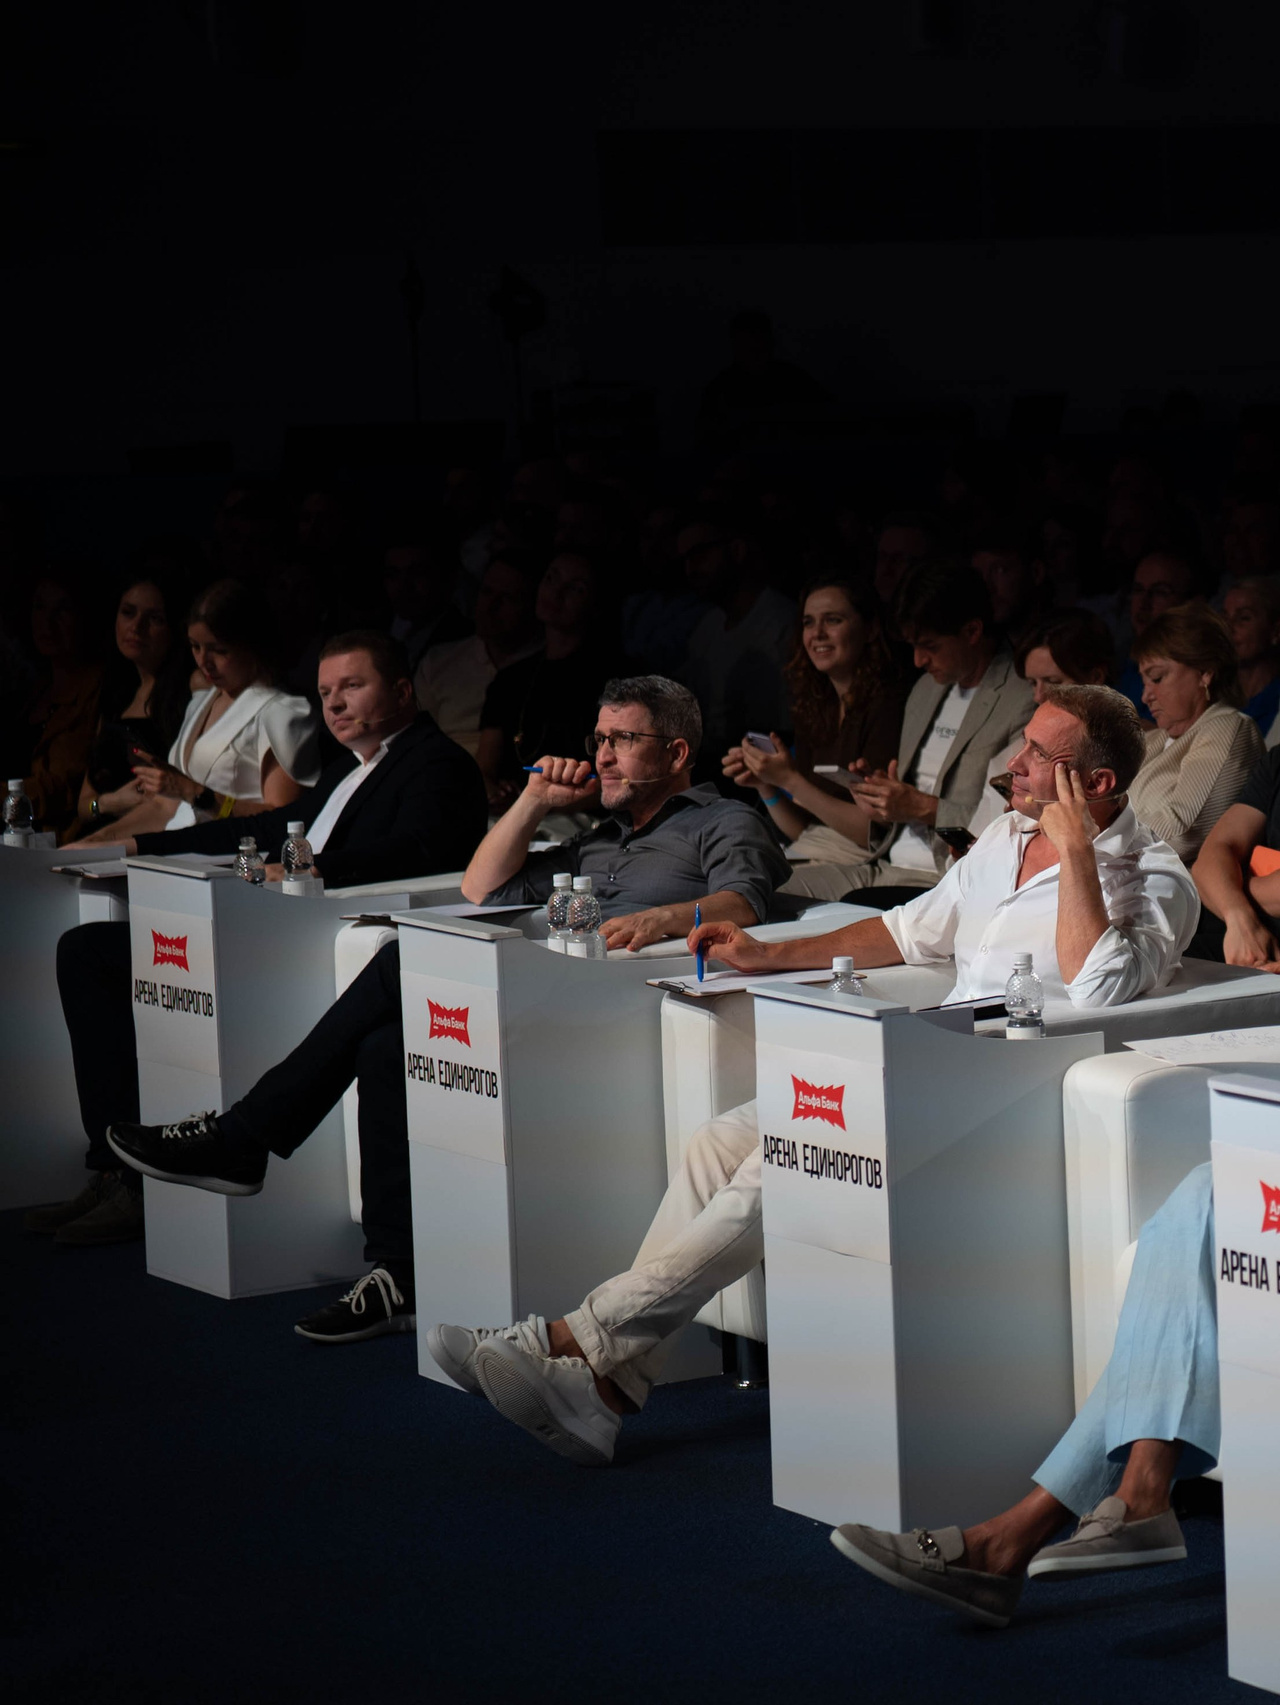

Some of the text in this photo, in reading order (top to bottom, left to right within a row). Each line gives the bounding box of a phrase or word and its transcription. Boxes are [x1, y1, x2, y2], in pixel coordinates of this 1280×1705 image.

[134, 979, 214, 1017] АРЕНА ЕДИНОРОГОВ
[432, 1013, 466, 1031] Альфа Банк
[408, 1052, 498, 1098] АРЕНА ЕДИНОРОГОВ
[798, 1090, 840, 1112] Альфа Банк
[764, 1134, 883, 1189] АРЕНА ЕДИНОРОГОВ
[1221, 1248, 1270, 1292] АРЕНА
